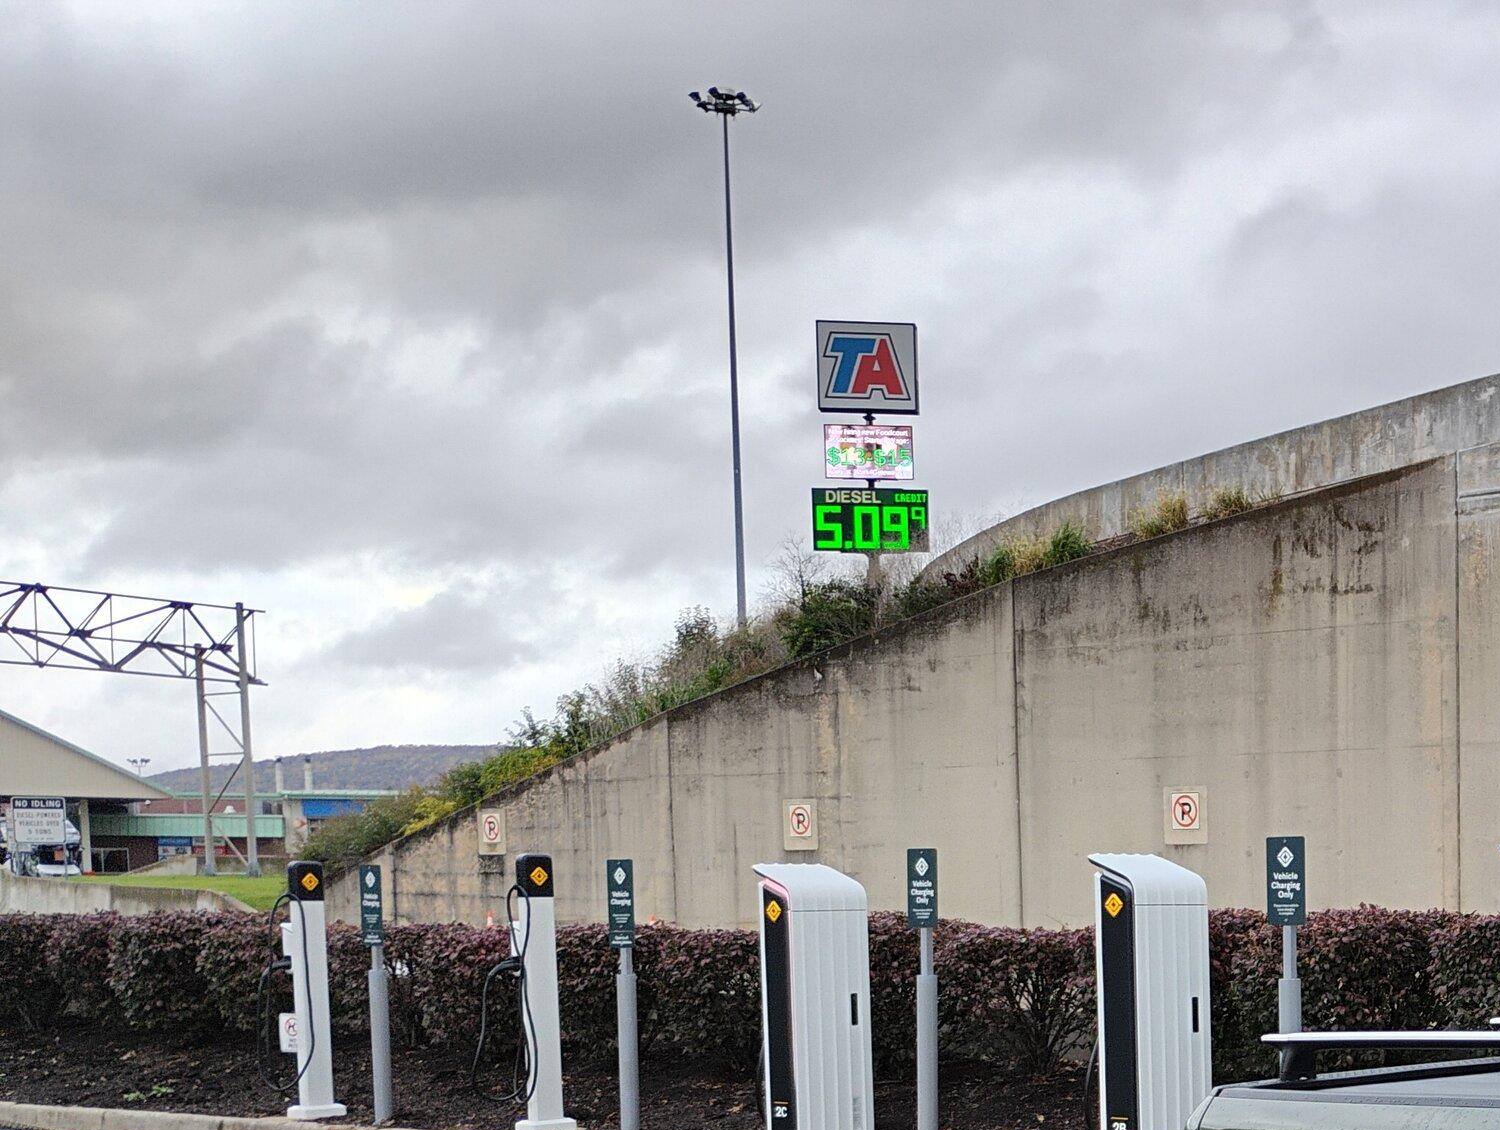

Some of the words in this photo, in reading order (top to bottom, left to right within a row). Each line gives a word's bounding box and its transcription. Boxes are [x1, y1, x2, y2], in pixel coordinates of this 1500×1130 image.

[825, 334, 909, 399] TA
[827, 446, 913, 467] $13-$15
[825, 490, 882, 504] DIESEL
[894, 493, 928, 503] CREDIT
[15, 800, 28, 808] NO
[31, 800, 61, 808] IDLING
[1273, 872, 1298, 880] Vehicle
[912, 880, 932, 888] Vehicle
[1271, 881, 1301, 891] Charging
[911, 889, 934, 897] Charging
[1278, 890, 1294, 900] Only
[774, 1105, 788, 1118] 2C
